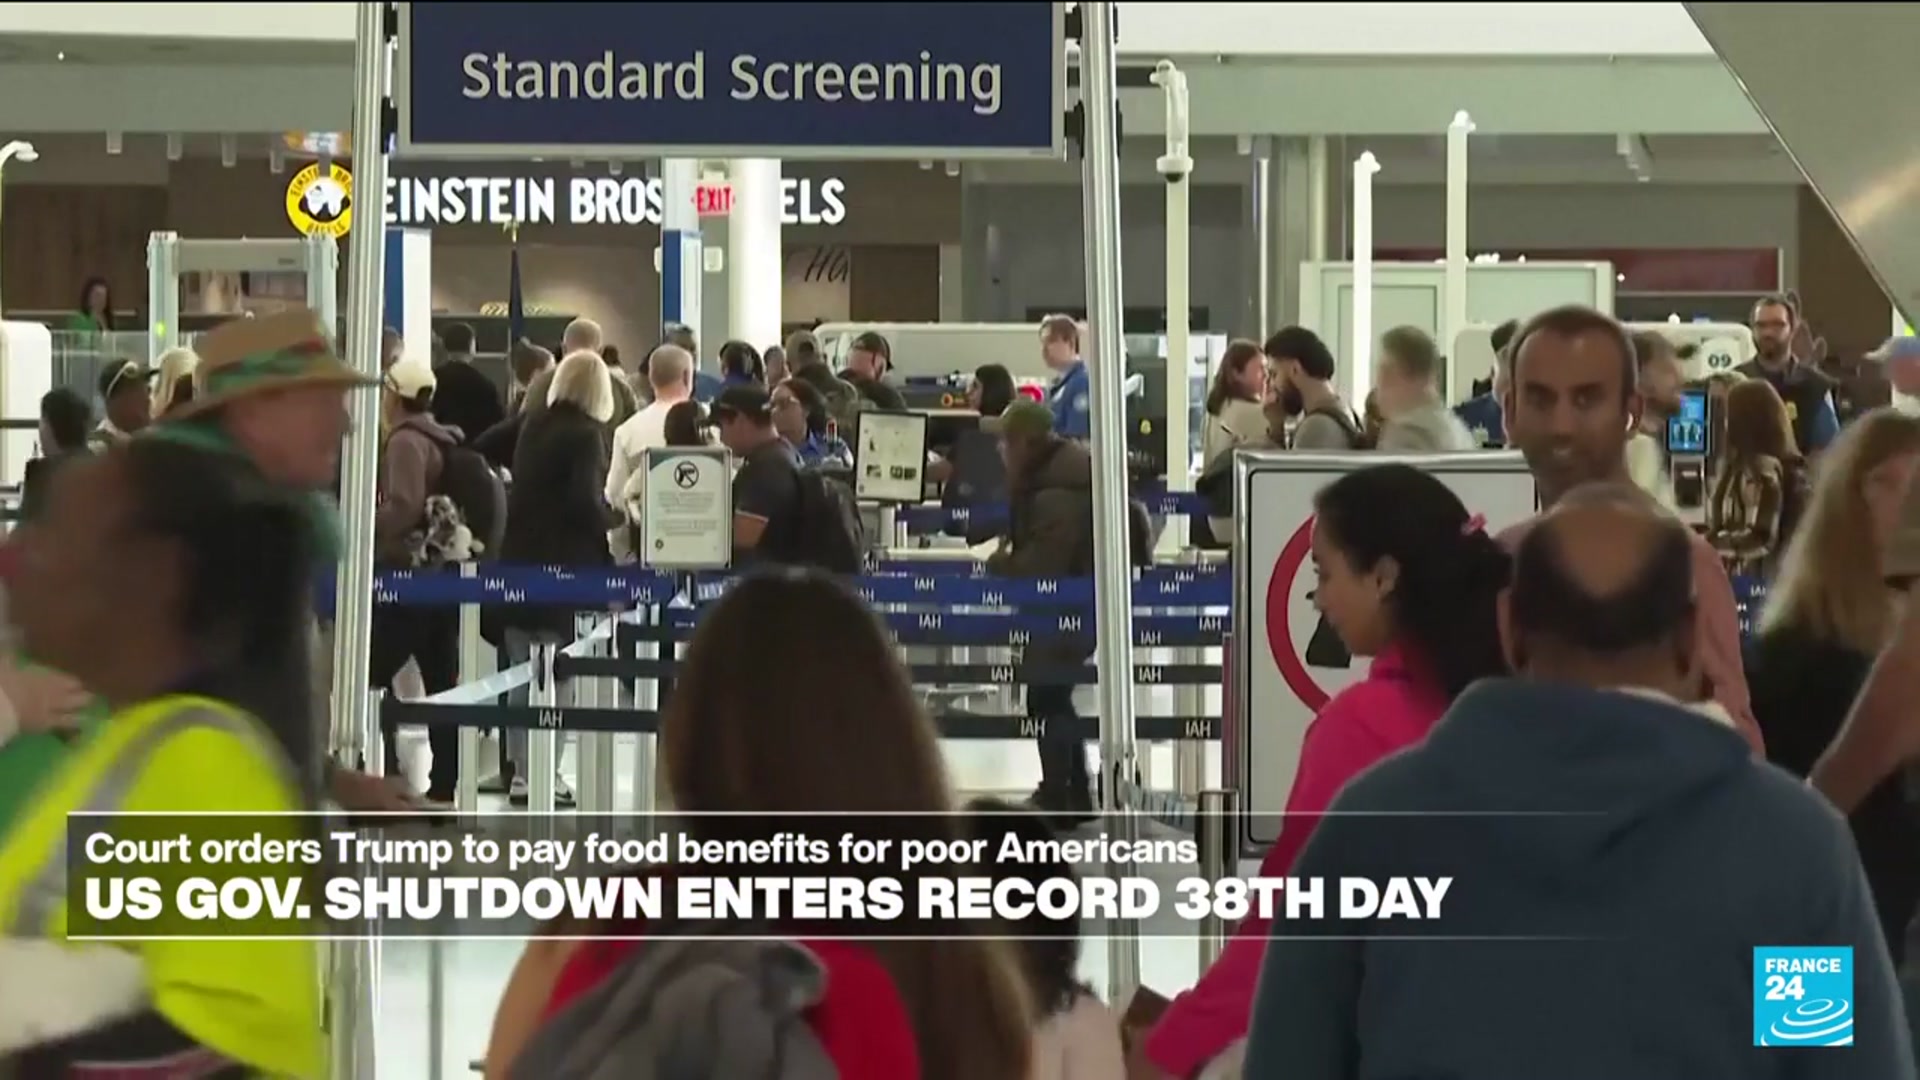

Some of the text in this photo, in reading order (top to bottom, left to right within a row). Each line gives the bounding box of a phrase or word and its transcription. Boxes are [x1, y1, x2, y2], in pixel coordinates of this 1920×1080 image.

[463, 51, 1001, 114] Standard Screening
[386, 177, 847, 226] EINSTEIN BROS ELS
[696, 185, 731, 213] EXIT
[1708, 353, 1732, 368] 09
[952, 509, 970, 520] IAH
[607, 577, 626, 589] IAH
[1175, 570, 1195, 582] IAH
[485, 578, 505, 591] IAH
[915, 578, 935, 591] IAH
[1037, 579, 1057, 593] IAH
[1160, 581, 1180, 594] IAH
[378, 590, 398, 603] IAH
[505, 590, 525, 603] IAH
[631, 587, 651, 599] IAH
[982, 592, 1003, 605] IAH
[920, 614, 942, 628] IAH
[1058, 616, 1081, 631] IAH
[1199, 617, 1222, 631] IAH
[1009, 630, 1030, 644] IAH
[1141, 630, 1161, 644] IAH
[991, 665, 1014, 682] IAH
[1139, 666, 1162, 682] IAH
[539, 710, 563, 728] IAH
[1020, 718, 1046, 737] IAH
[1185, 720, 1212, 738] IAH
